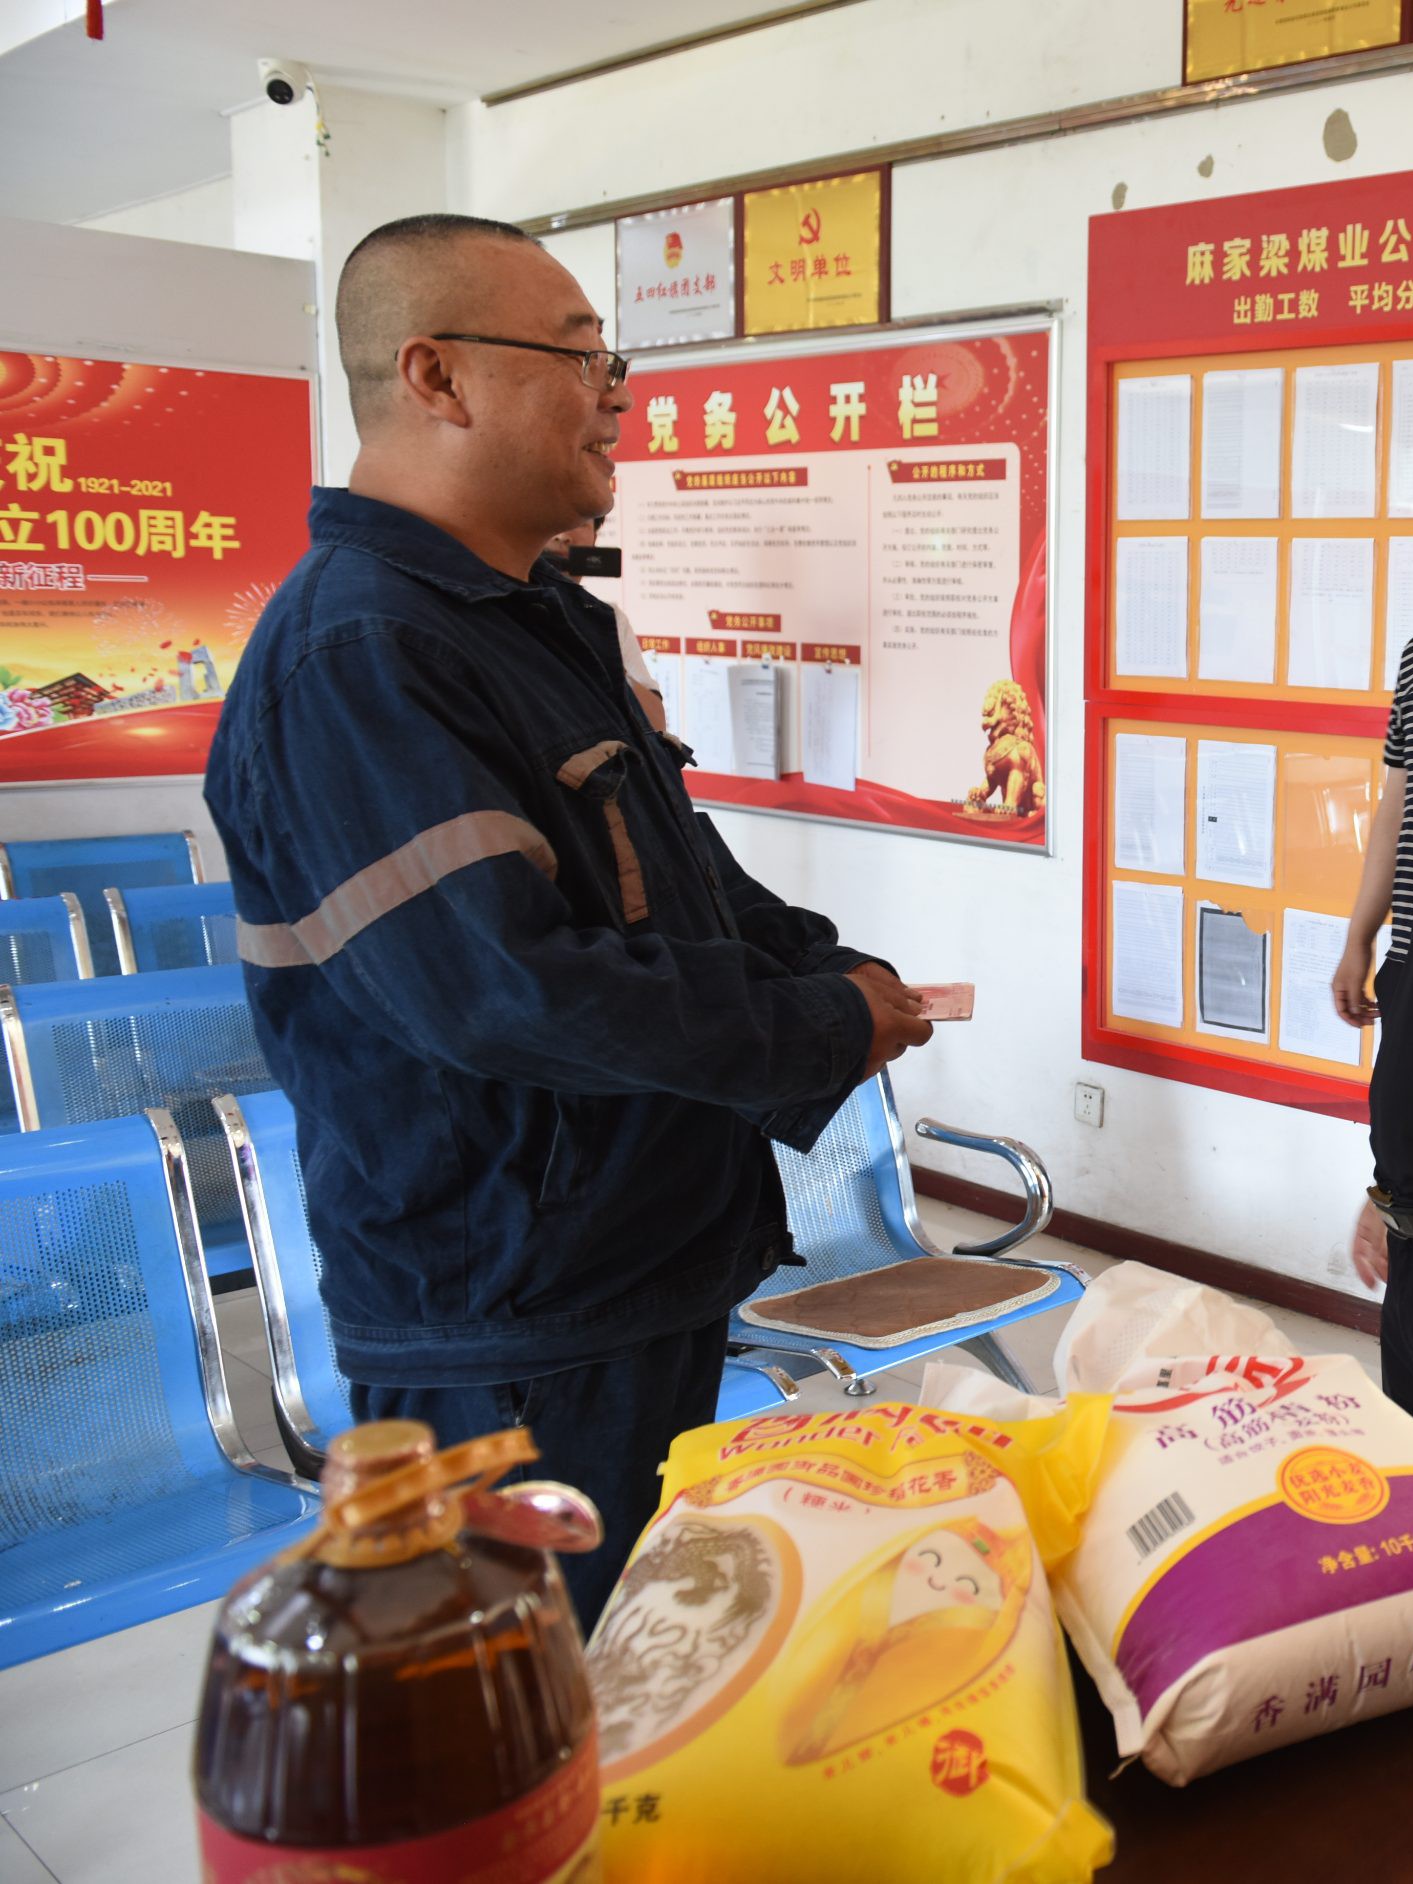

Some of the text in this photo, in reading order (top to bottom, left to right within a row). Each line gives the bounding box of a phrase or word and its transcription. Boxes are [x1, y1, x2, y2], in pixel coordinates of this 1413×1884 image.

[767, 253, 853, 286] 文明单位
[1233, 289, 1320, 324] 出勤工数
[645, 373, 940, 455] 党务公开栏
[0, 433, 73, 493] 祝
